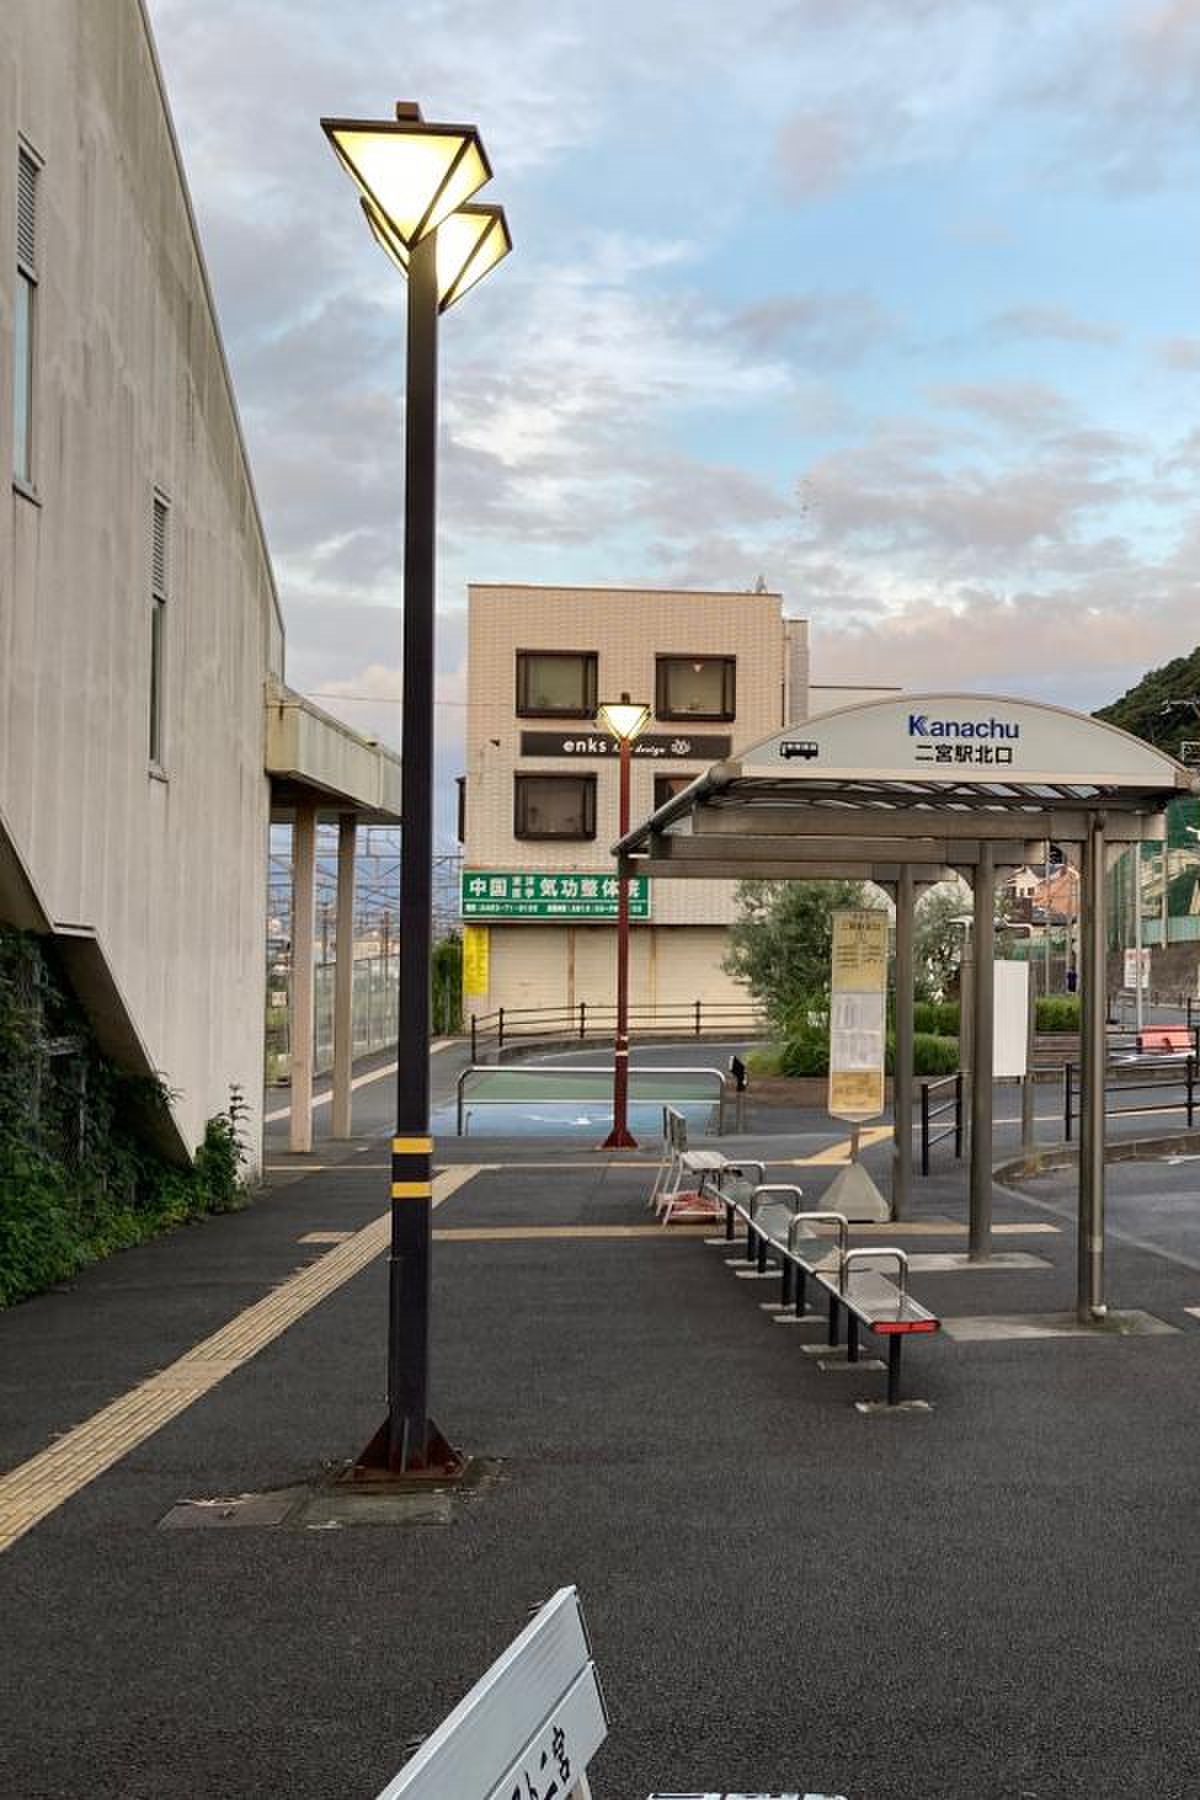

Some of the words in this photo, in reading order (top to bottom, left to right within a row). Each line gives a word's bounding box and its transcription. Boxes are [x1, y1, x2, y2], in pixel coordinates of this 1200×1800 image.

[908, 714, 1020, 739] Kanachu
[562, 737, 607, 753] enks
[914, 743, 1013, 765] 二宮駅北口
[469, 877, 508, 897] 中国
